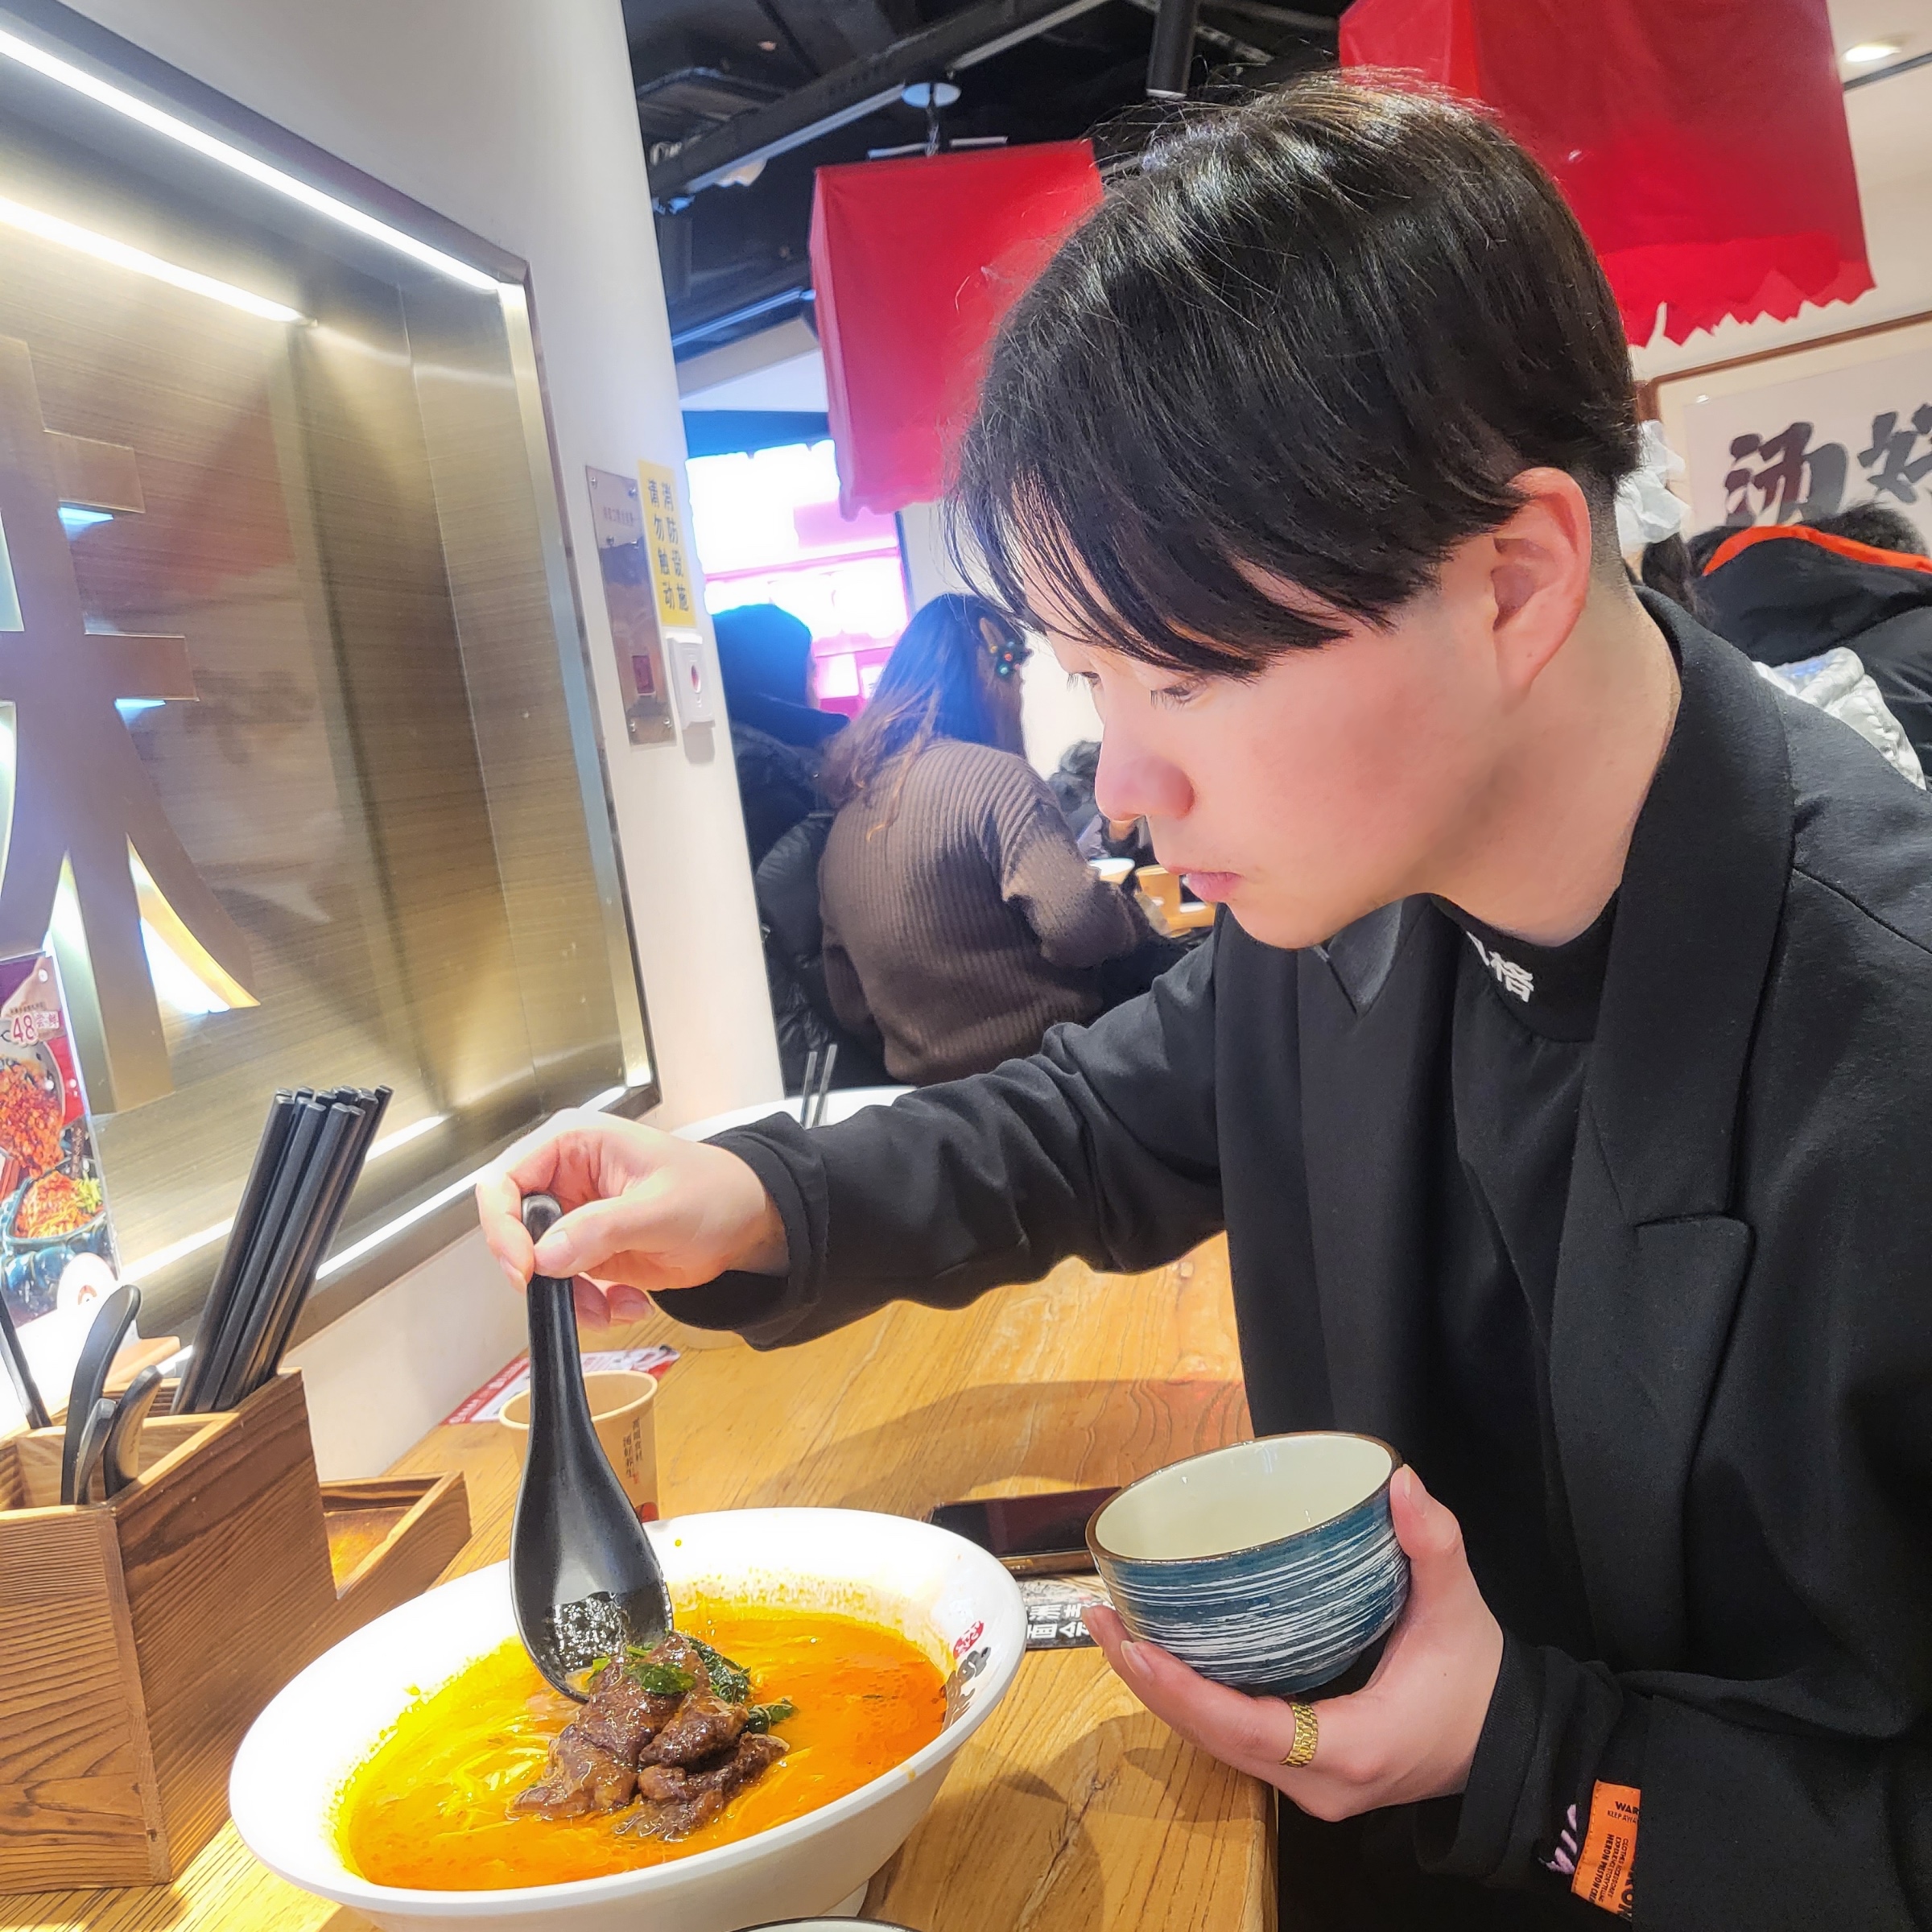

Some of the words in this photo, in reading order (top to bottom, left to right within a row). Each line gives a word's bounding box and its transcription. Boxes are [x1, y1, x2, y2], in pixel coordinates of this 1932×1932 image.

[647, 479, 675, 610] 请勿触动
[662, 481, 689, 611] 消防设施
[14, 1015, 35, 1042] 48
[1602, 1833, 1615, 1861] HERON
